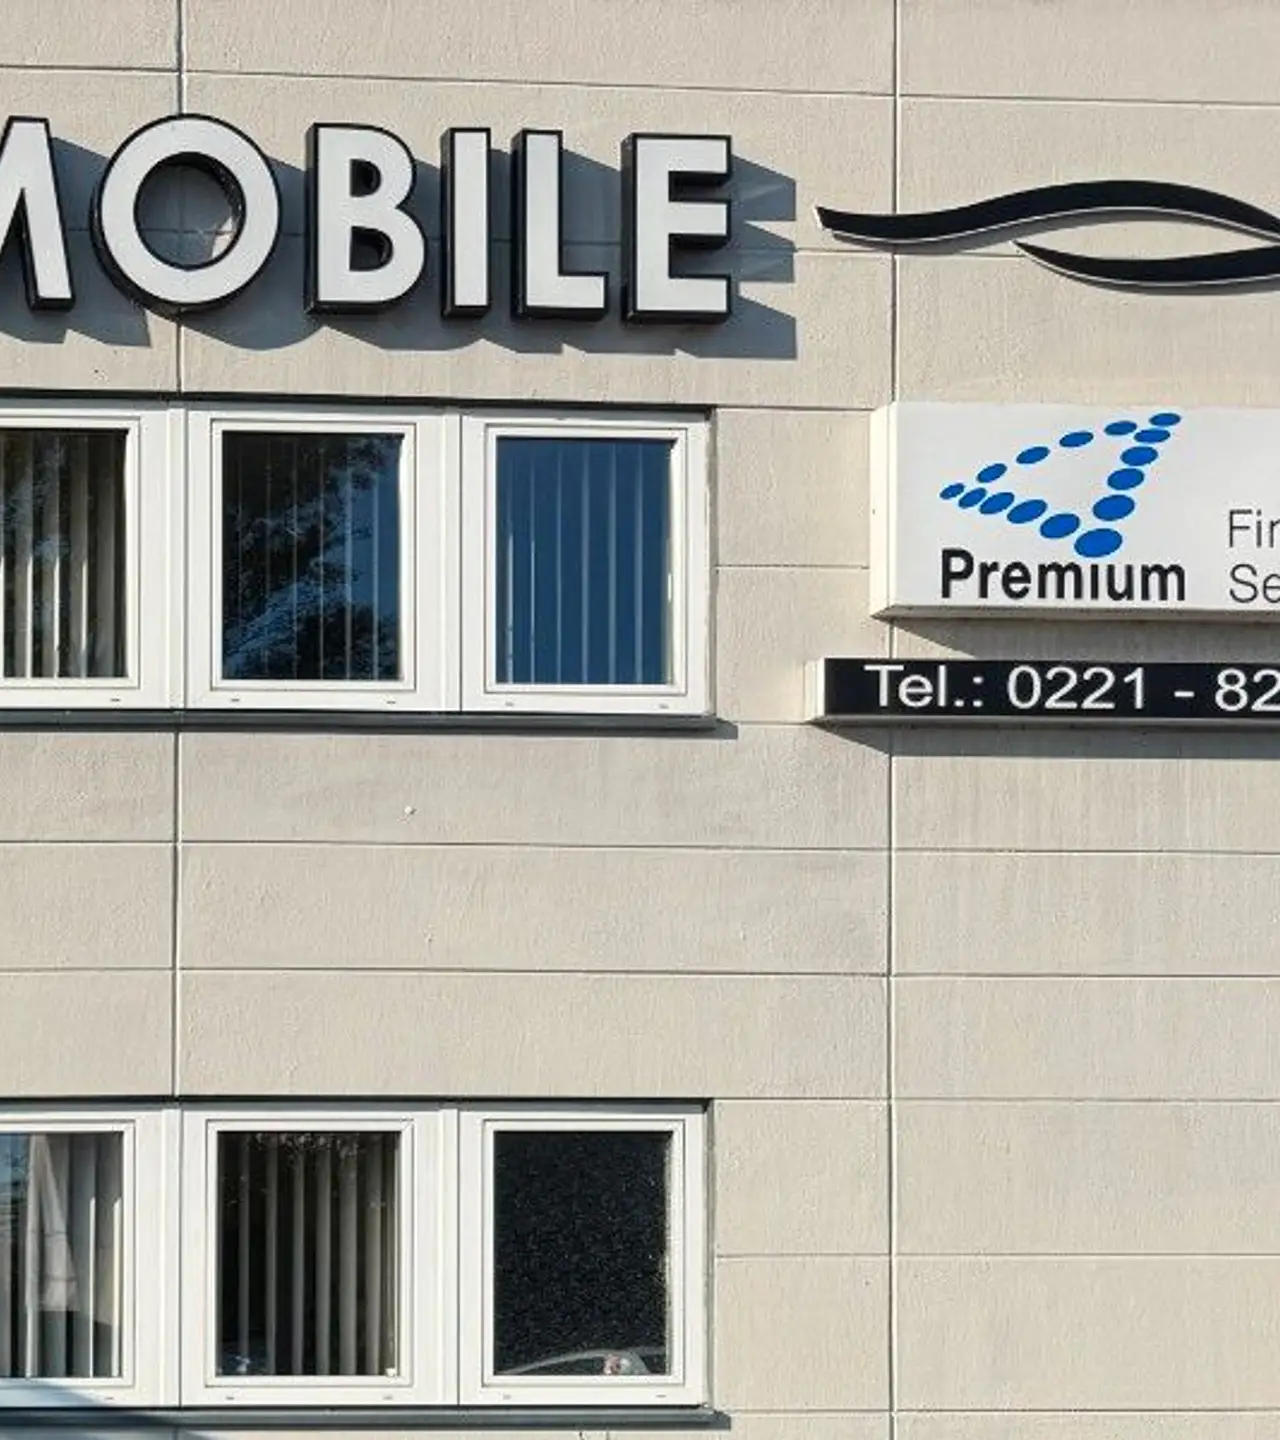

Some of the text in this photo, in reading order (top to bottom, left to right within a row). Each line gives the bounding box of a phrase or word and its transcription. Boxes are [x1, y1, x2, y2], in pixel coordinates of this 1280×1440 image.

[940, 548, 1186, 602] Premium
[864, 664, 984, 708] Tel.:
[1007, 666, 1147, 710] 0221
[1214, 667, 1280, 712] 82
